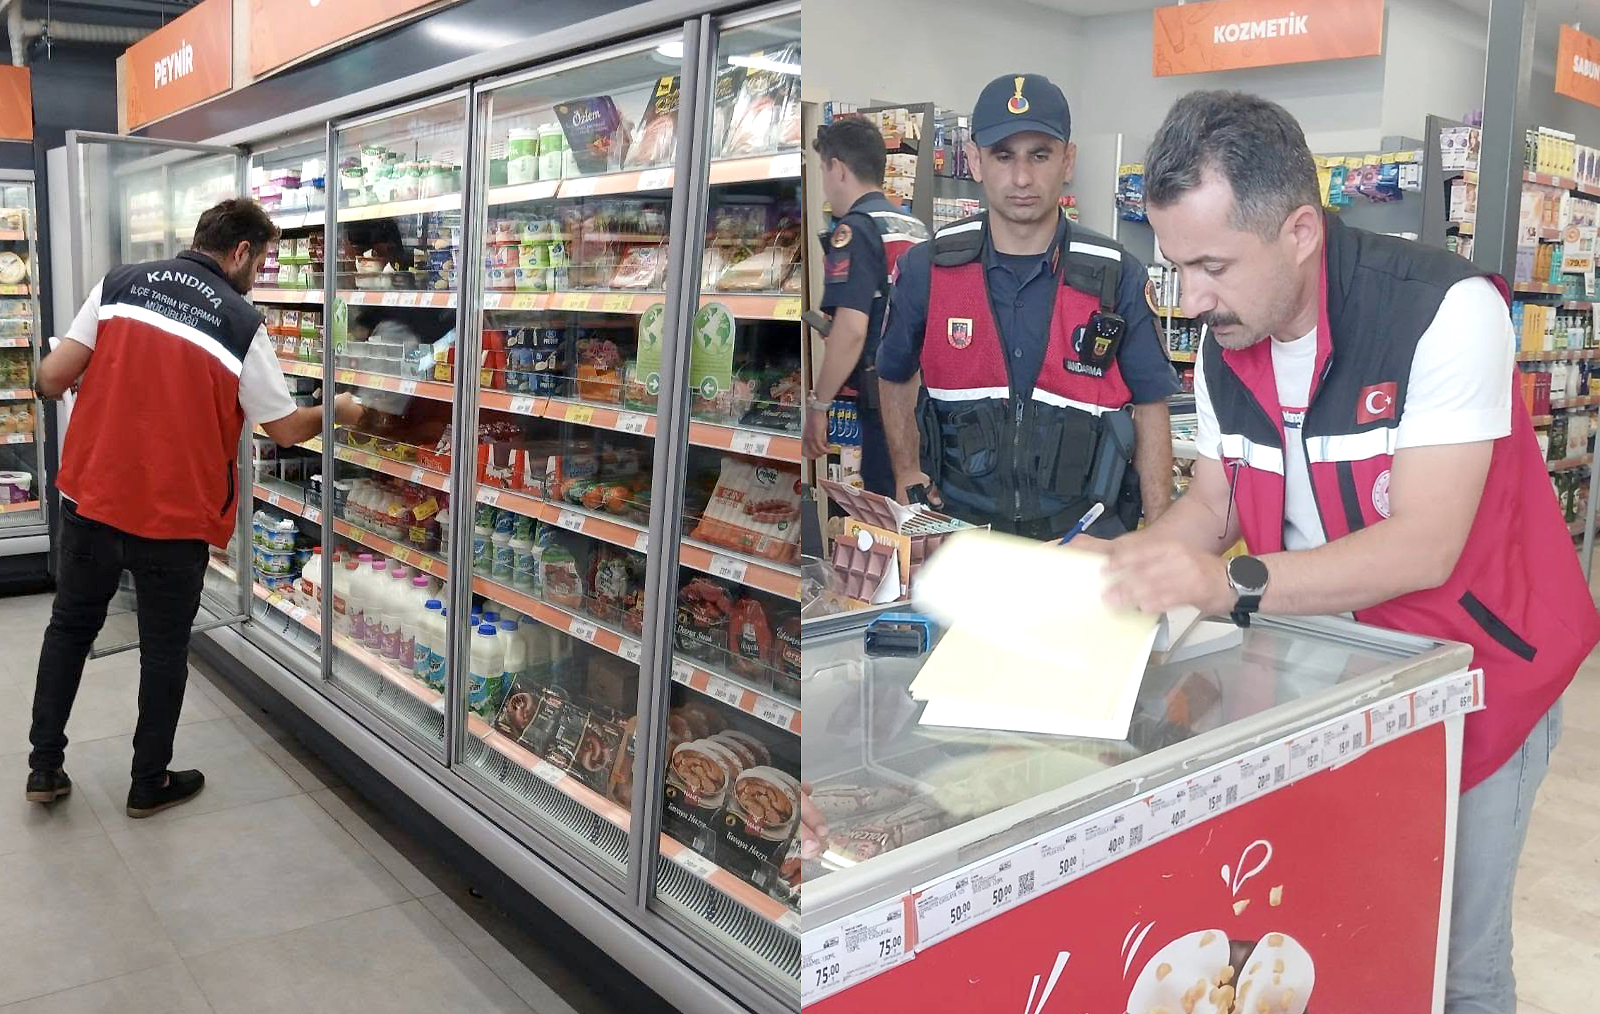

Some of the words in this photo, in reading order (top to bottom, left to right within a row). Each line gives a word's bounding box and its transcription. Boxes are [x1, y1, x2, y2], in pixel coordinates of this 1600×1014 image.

[1213, 11, 1309, 44] KOZMETİK
[153, 39, 194, 89] PEYNİR
[130, 284, 150, 297] İLÇE
[151, 290, 177, 308] TARIM
[178, 300, 191, 313] VE
[190, 306, 222, 327] ORMAN
[146, 270, 222, 310] KANDIRA
[144, 299, 199, 327] MÜDÜRLÜĞÜ
[1066, 360, 1103, 377] JANDARMA
